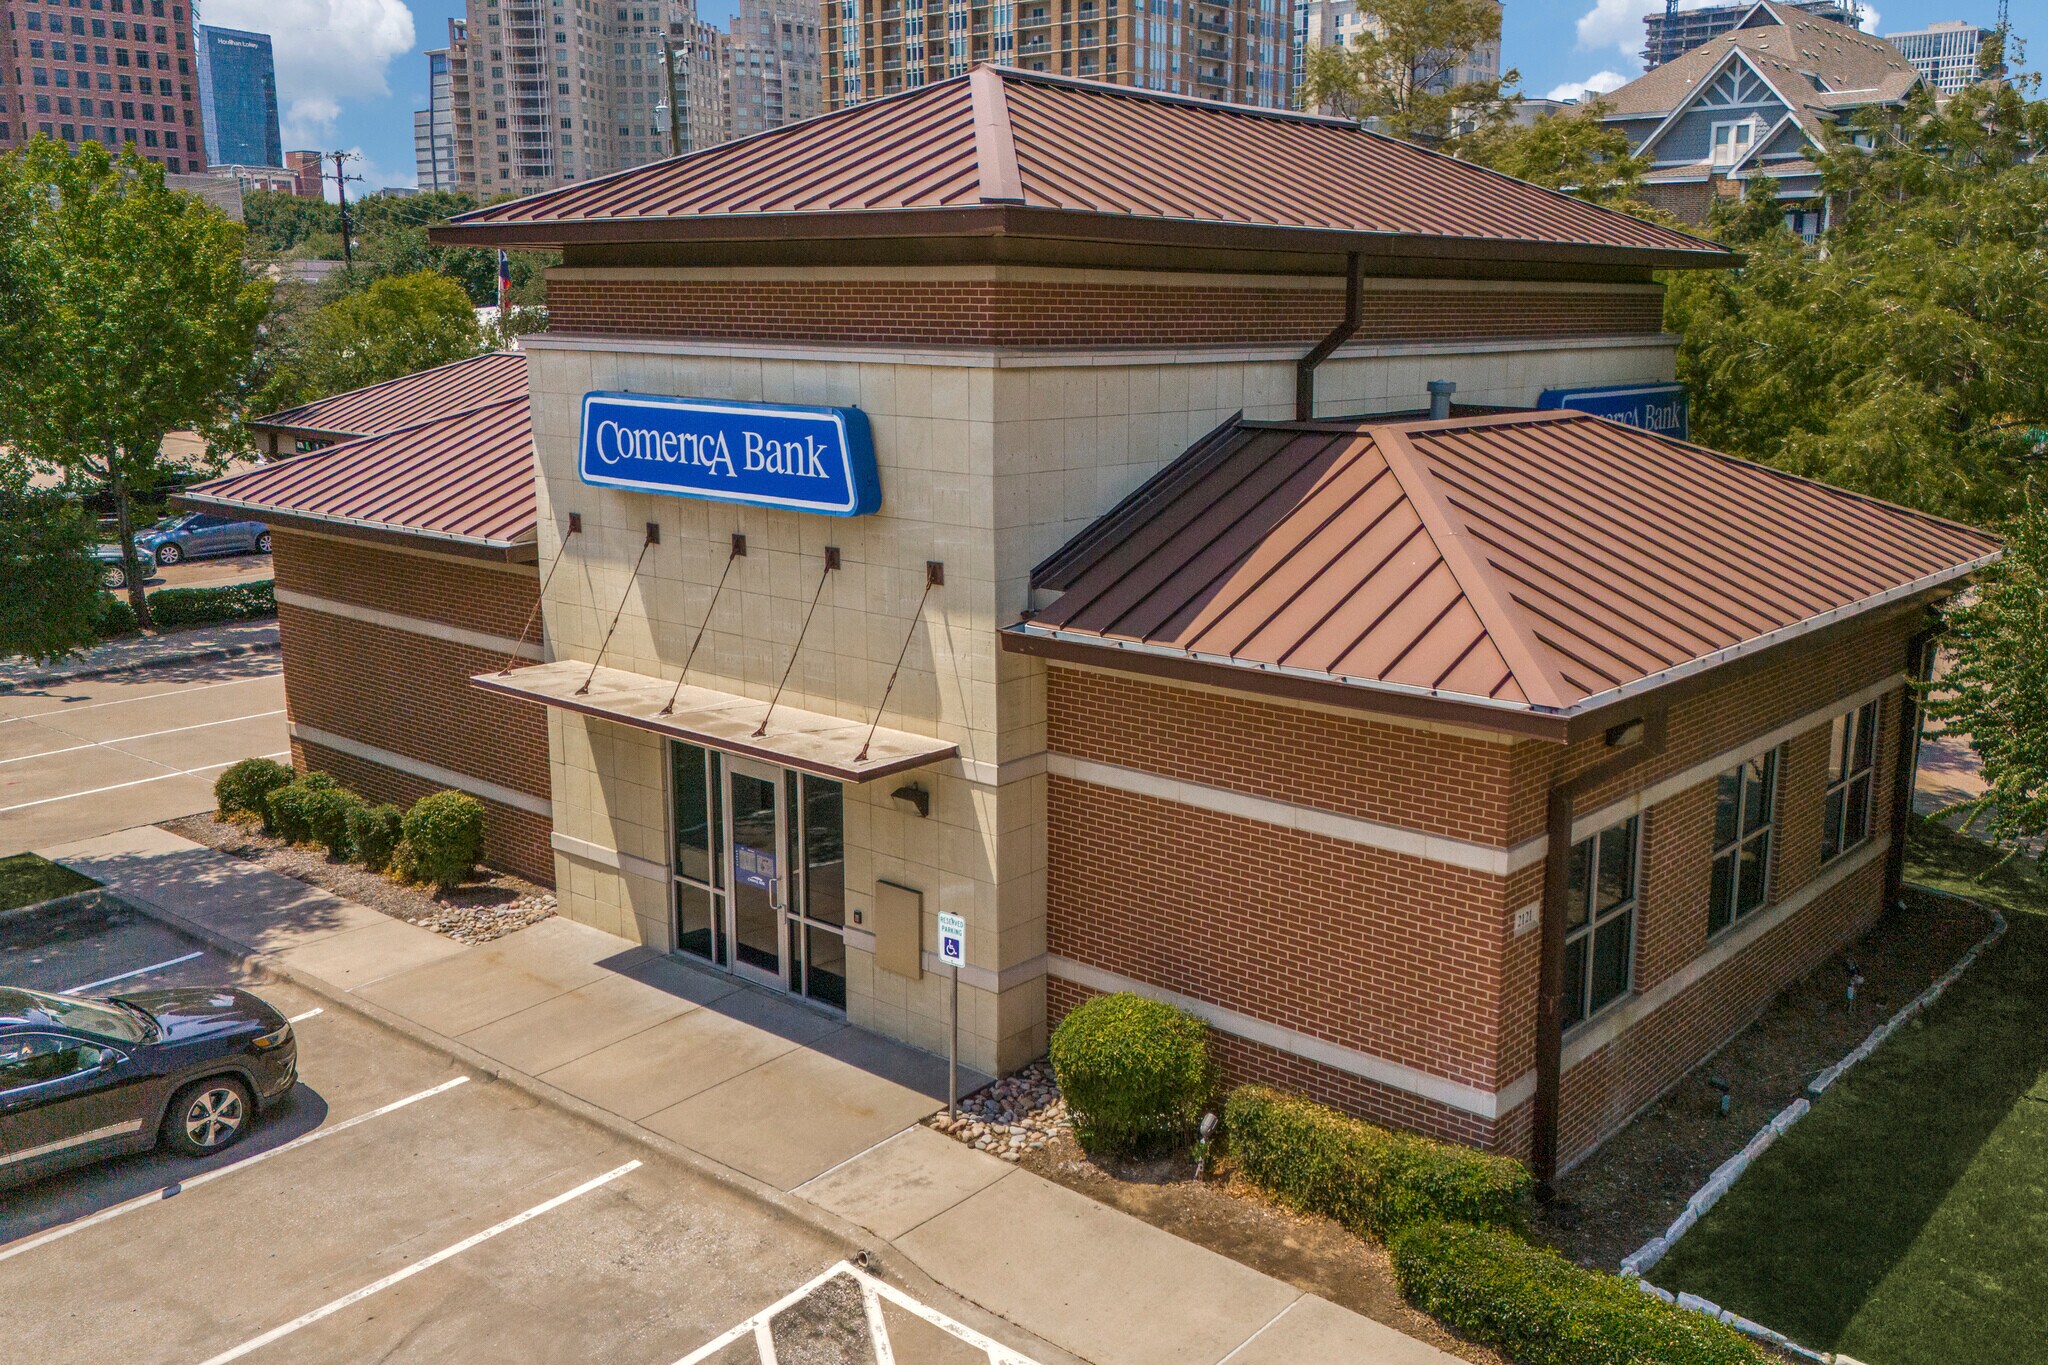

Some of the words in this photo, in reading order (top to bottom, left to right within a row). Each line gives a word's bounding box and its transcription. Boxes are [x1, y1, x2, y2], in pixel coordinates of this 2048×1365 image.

[1645, 401, 1682, 431] Bank
[742, 430, 830, 479] Bank
[940, 916, 964, 928] RESERVED
[941, 925, 963, 936] PARKING
